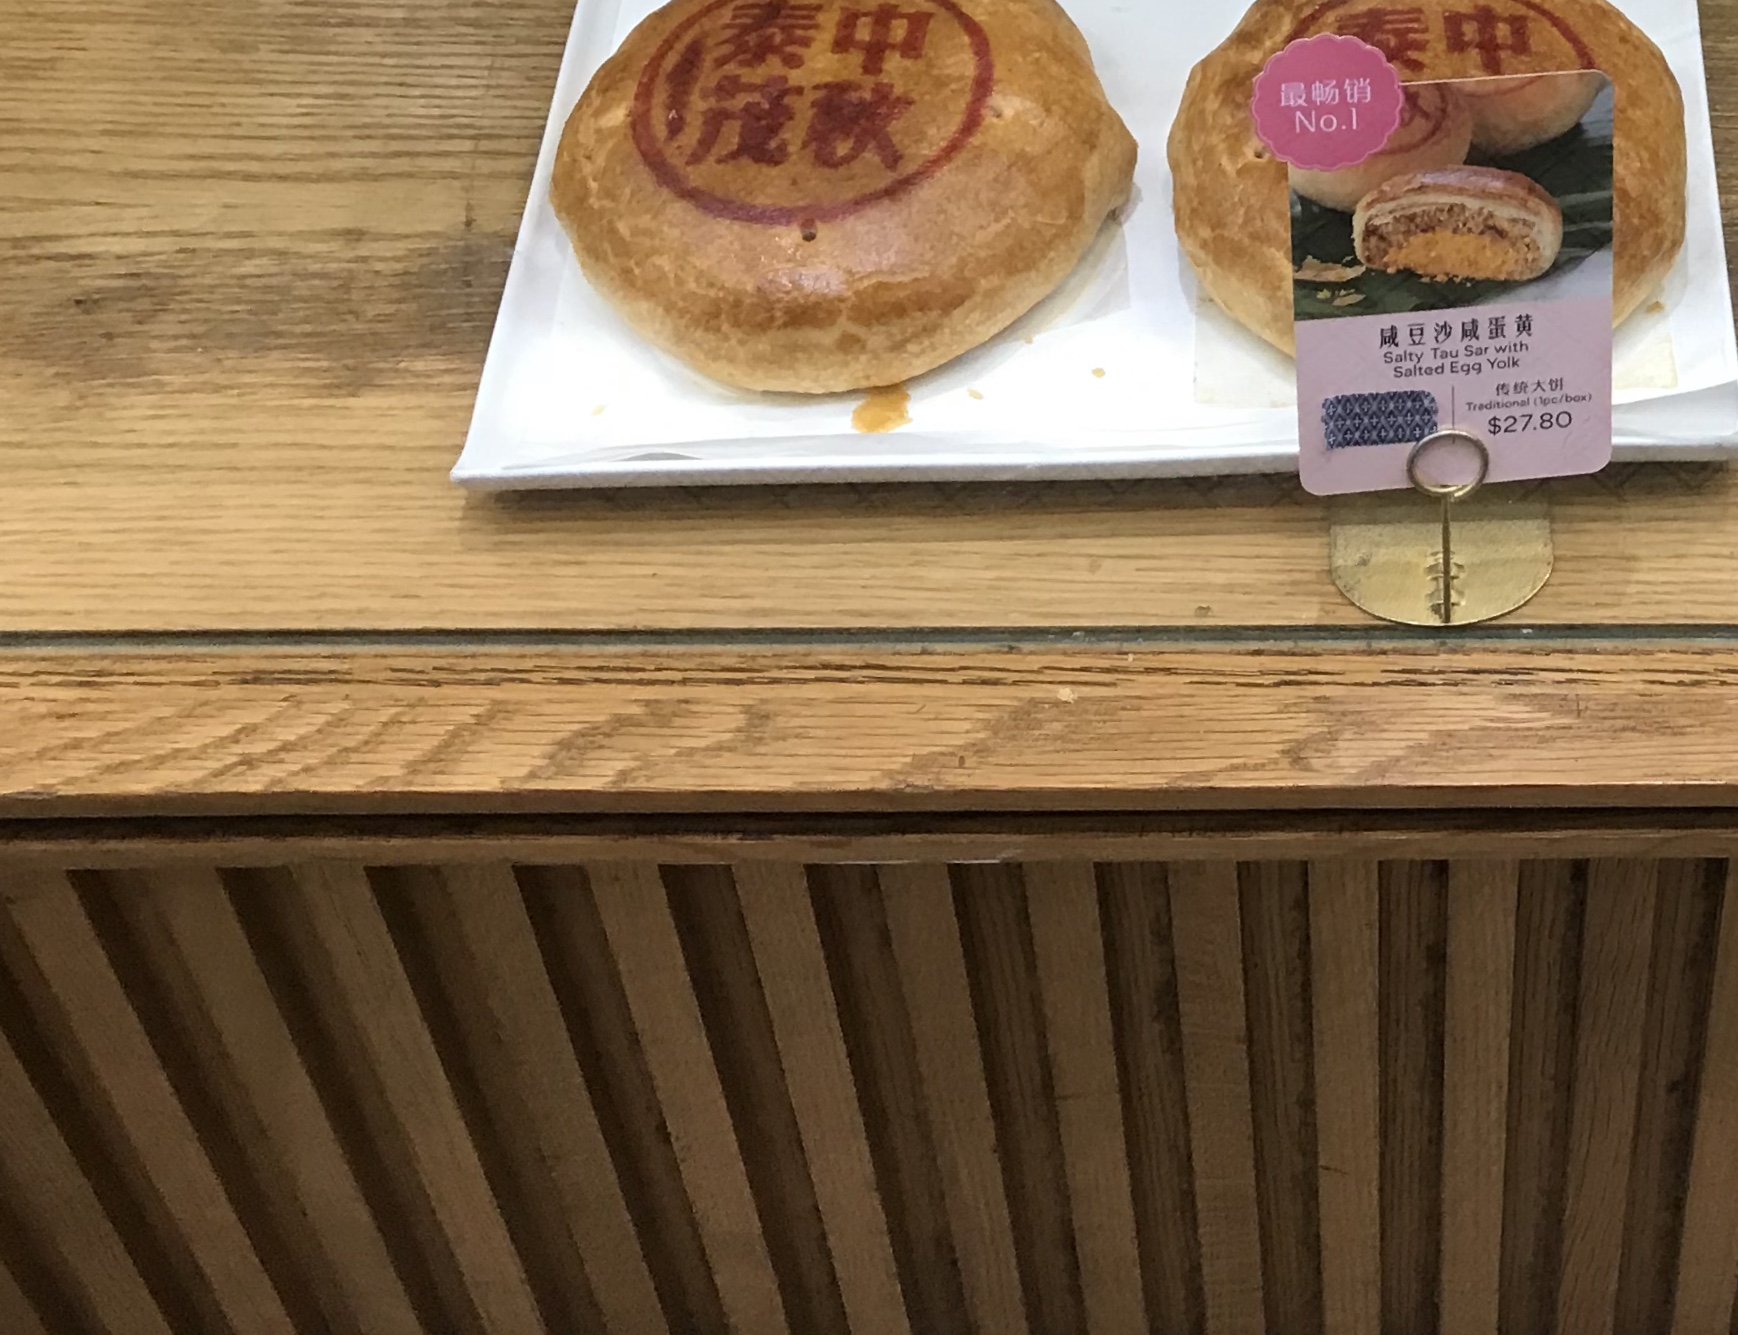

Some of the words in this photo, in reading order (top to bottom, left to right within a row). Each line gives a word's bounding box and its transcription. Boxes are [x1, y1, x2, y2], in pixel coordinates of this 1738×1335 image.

[1280, 77, 1371, 107] 最畅销
[1295, 107, 1357, 134] No.1
[1379, 313, 1533, 349] 咸豆沙咸蛋黄
[1383, 349, 1424, 365] Salty
[1431, 347, 1459, 360] Tau
[1464, 344, 1489, 357] Sar
[1494, 340, 1529, 354] with
[1393, 363, 1445, 378] Salted
[1450, 361, 1482, 375] Egg
[1486, 356, 1521, 370] Yolk
[1495, 377, 1564, 396] 传统大饼
[1466, 397, 1530, 411] Traditional
[1534, 392, 1592, 407] (1pc/box)
[1487, 410, 1573, 436] $27.80
